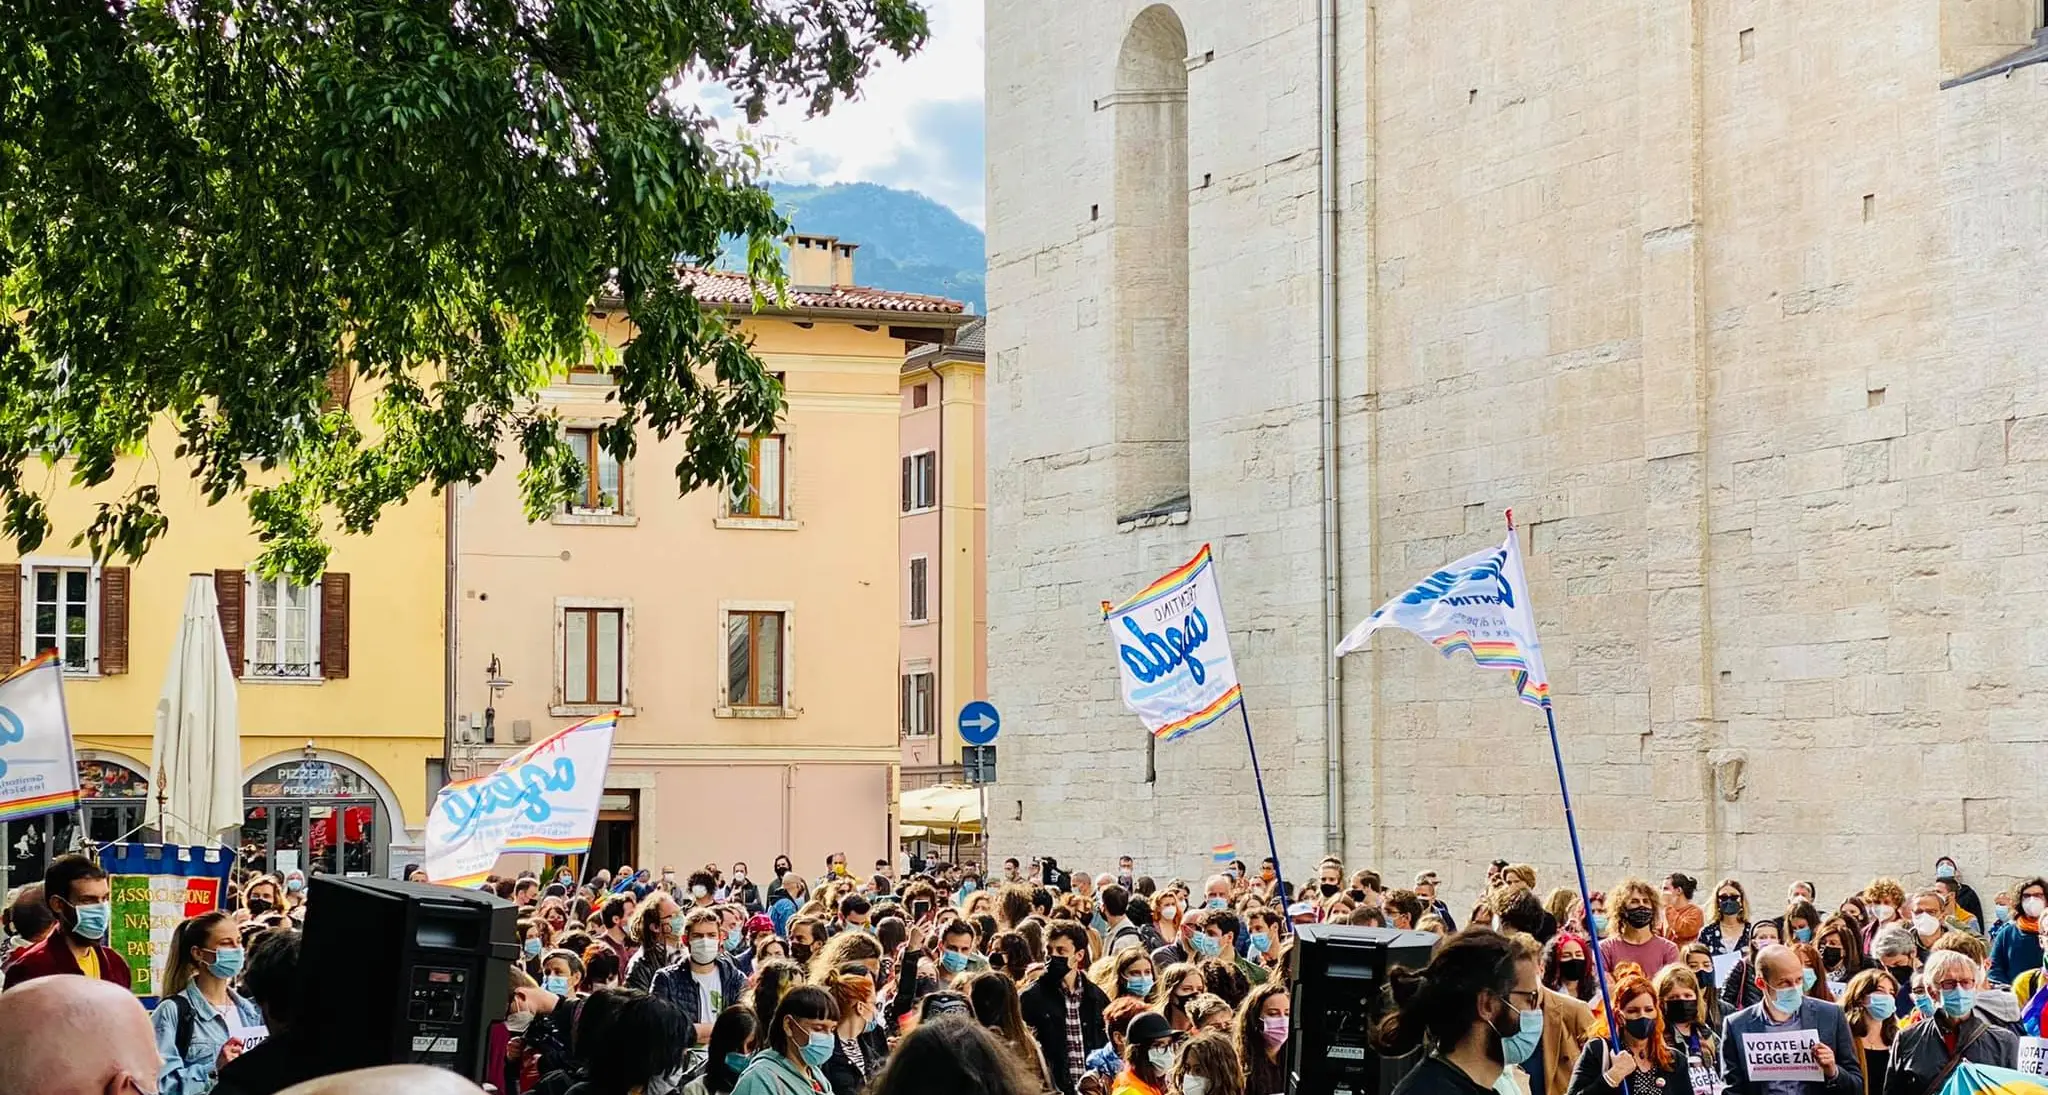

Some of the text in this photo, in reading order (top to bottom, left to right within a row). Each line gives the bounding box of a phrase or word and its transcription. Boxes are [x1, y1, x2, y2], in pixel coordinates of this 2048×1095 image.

[278, 768, 340, 780] PIZZERIA
[283, 786, 313, 795] PIZZA
[340, 786, 368, 795] PALA
[1747, 1038, 1816, 1051] VOTATE LA
[1748, 1053, 1790, 1065] LEGGE
